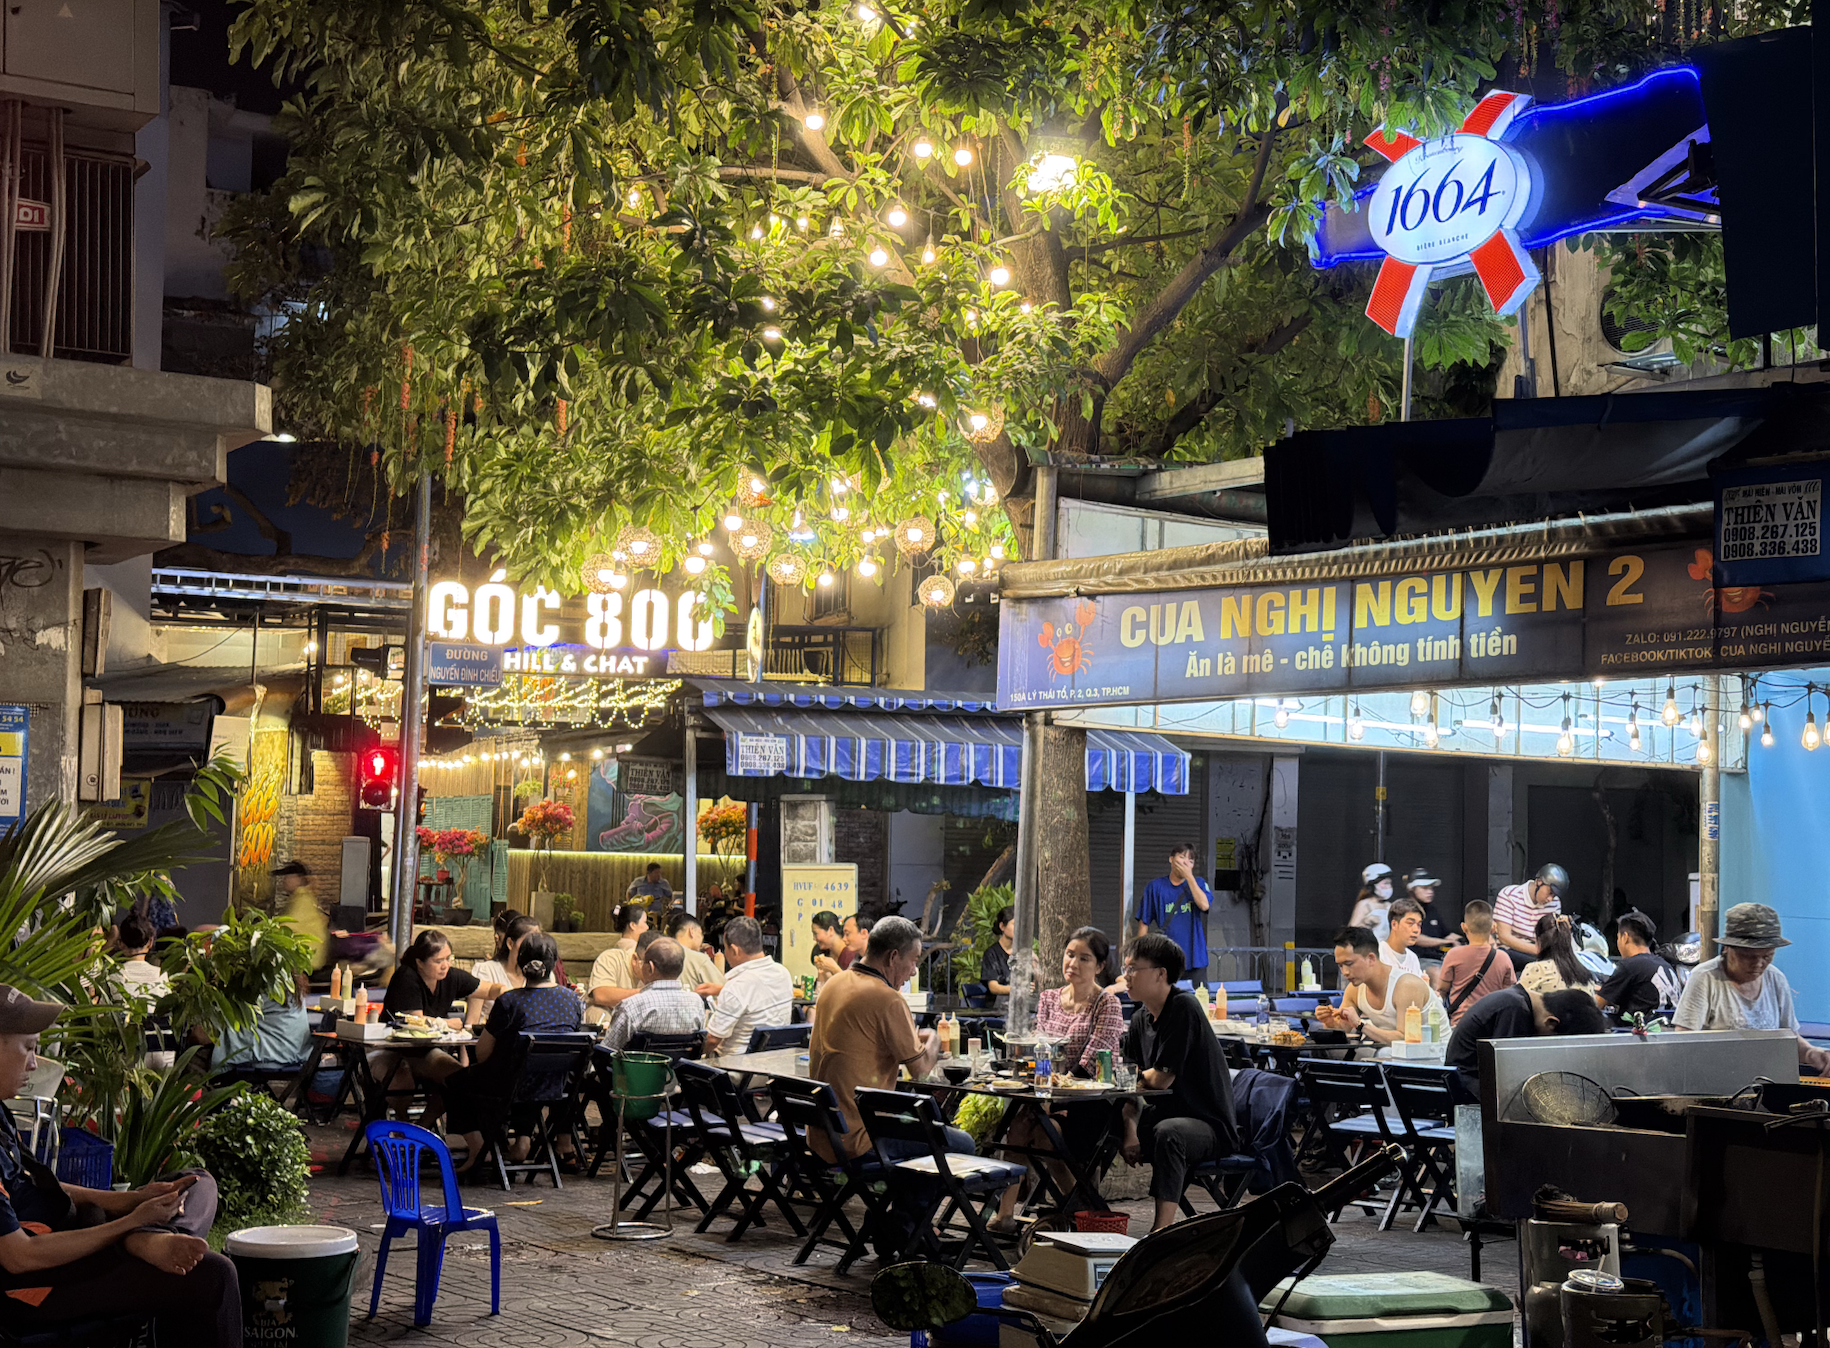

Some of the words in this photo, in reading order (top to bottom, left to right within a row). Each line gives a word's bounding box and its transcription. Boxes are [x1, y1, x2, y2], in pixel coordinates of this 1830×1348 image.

[1385, 157, 1501, 237] 1664
[1439, 233, 1468, 246] BLANCHE
[1724, 500, 1776, 526] THIÊN
[1782, 496, 1817, 521] VĂN
[1724, 522, 1816, 542] 0908.267.125
[1723, 538, 1818, 559] 0908.336.438
[428, 569, 561, 647] GÓC
[1120, 600, 1205, 648] CUA
[1220, 586, 1336, 642] NGHỊ
[1606, 555, 1645, 606] 2
[1625, 632, 1660, 645] ZALO:
[1663, 626, 1738, 643] 091.222.9797
[1741, 624, 1777, 640] (NGHỊ
[445, 647, 489, 661] ĐƯỜNG
[1185, 650, 1210, 678] Ăn
[1217, 651, 1236, 676] là
[1242, 648, 1273, 674] mê
[1295, 645, 1334, 671] chê
[1341, 640, 1410, 667] không
[1417, 634, 1460, 663] tính
[1470, 626, 1517, 658] tiền
[1720, 645, 1746, 657] CUA
[1749, 642, 1782, 656] NGHỊ
[430, 663, 460, 680] NGUYỄN
[461, 665, 478, 681] ĐÌNH
[560, 653, 577, 674] &
[583, 653, 649, 675] CHAT
[1010, 692, 1026, 702] 150A
[1028, 690, 1037, 701] LÝ
[1039, 688, 1055, 700] THÁI
[240, 823, 273, 867] 800
[824, 882, 849, 891] 4639
